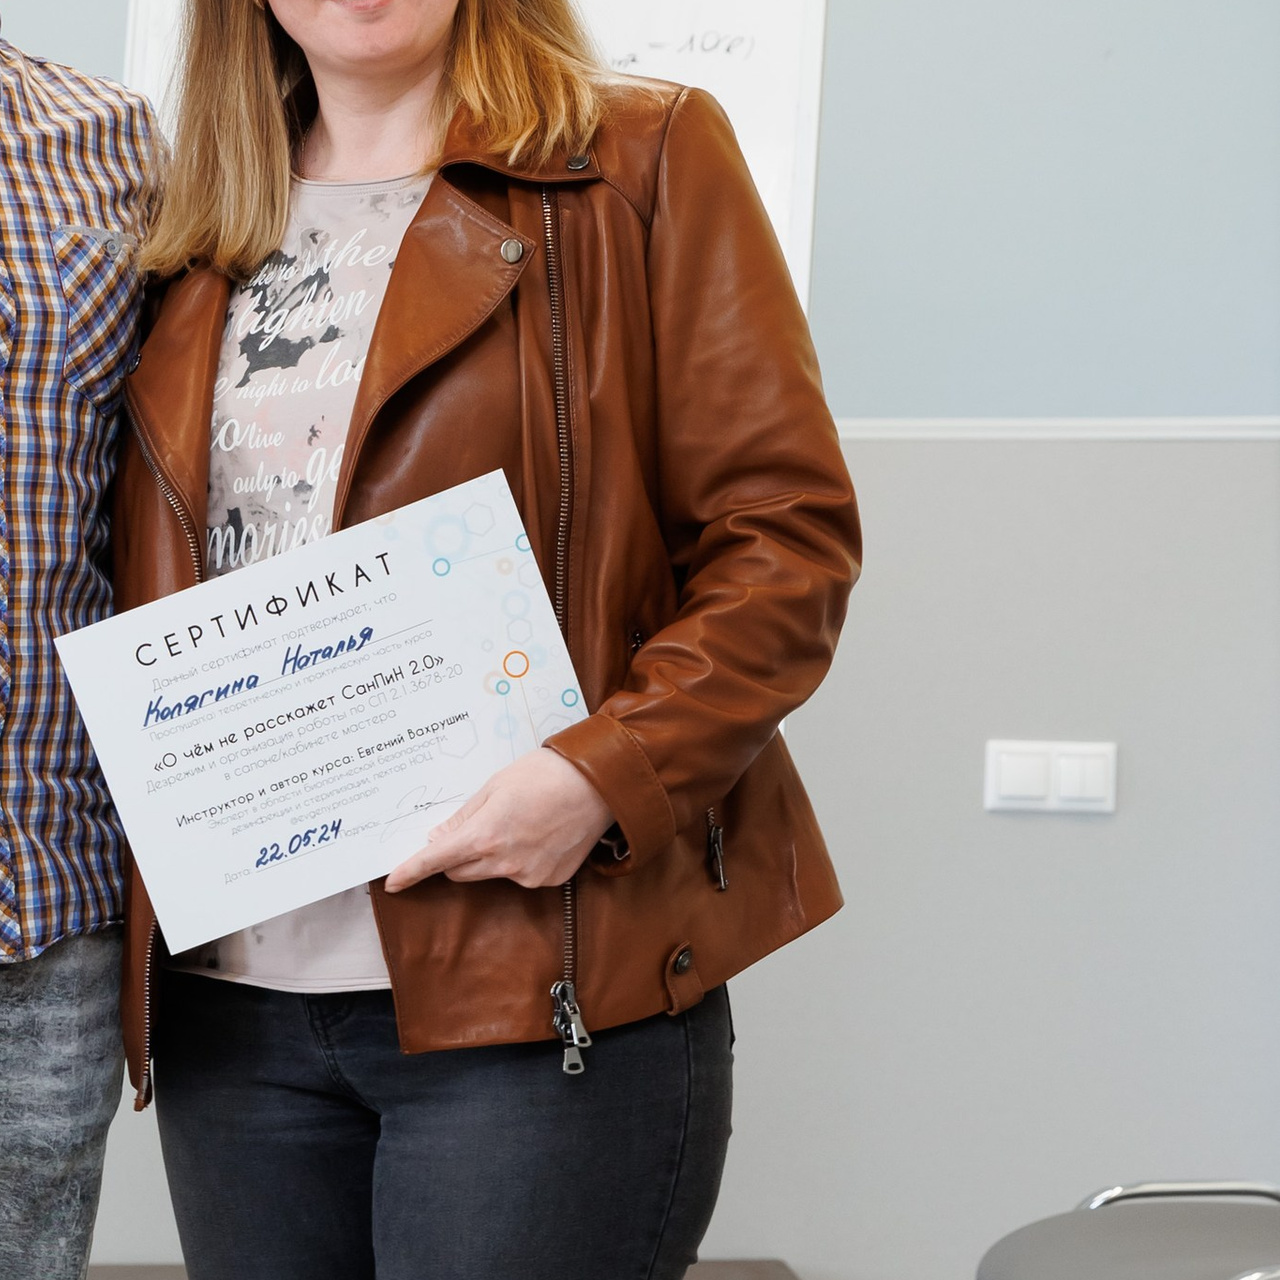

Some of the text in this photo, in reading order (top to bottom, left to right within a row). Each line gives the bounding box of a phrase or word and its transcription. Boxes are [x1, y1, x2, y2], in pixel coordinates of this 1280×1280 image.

[322, 228, 394, 274] the
[290, 375, 313, 394] to
[281, 466, 301, 490] to
[135, 551, 391, 667] СЕРТИФИКАТ
[151, 592, 398, 694] Данный сертификат подтверждает, что
[142, 626, 377, 728] Колягина Наталья
[216, 681, 293, 716] теоретическую
[293, 678, 302, 688] и
[300, 651, 371, 685] практическую
[371, 640, 403, 657] часть
[401, 629, 433, 648] курса
[146, 761, 207, 796] Дезрежим
[207, 760, 217, 770] и
[218, 728, 296, 768] организация
[294, 706, 349, 739] работы
[347, 701, 368, 718] по
[365, 691, 389, 710] СП
[153, 654, 444, 772] «О чём не расскажет СанПиН 2.0»
[223, 709, 397, 781] в салоне/кабинете мастера
[175, 711, 470, 828] Инструктор и автор курса: Евгений Вахрушин
[372, 759, 408, 782] лектор
[407, 748, 434, 767] НОЦ
[206, 806, 249, 830] Эксперт
[256, 784, 303, 812] области
[255, 818, 347, 869] 22.05.24
